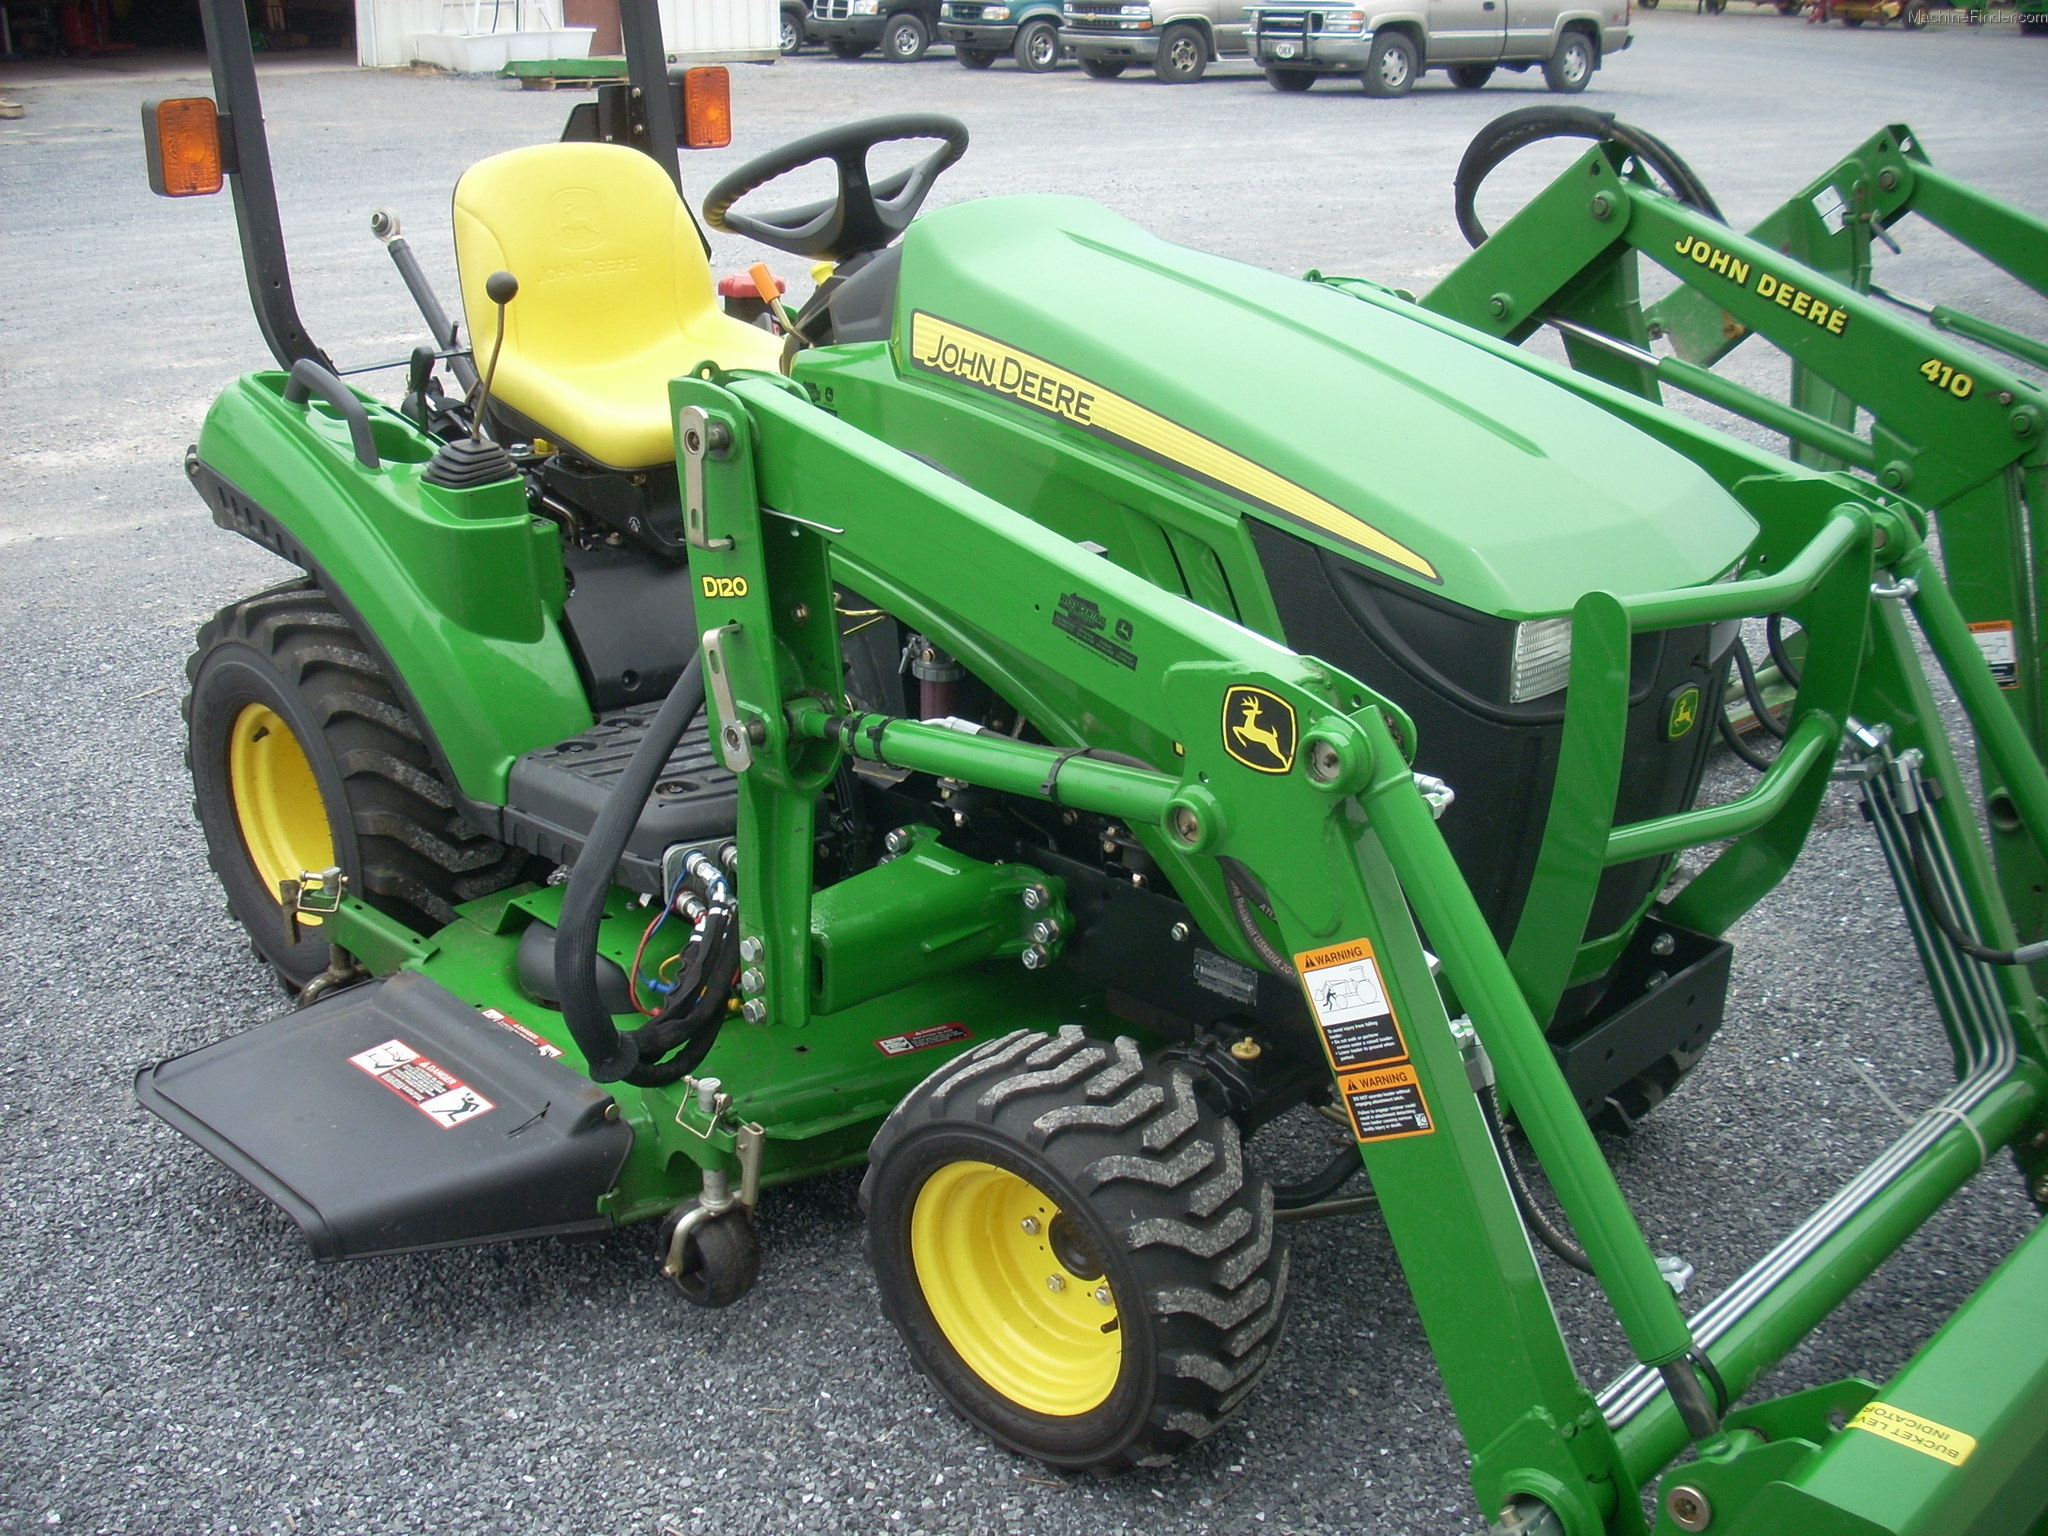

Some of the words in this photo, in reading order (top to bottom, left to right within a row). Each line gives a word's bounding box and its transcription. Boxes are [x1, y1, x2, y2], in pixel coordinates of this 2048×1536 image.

[582, 256, 639, 277] DEERE
[1674, 234, 1751, 285] JOHN
[1755, 272, 1849, 336] DEERE
[927, 335, 996, 383] JOHN
[999, 356, 1095, 422] DEERE
[1919, 357, 1974, 399] 410
[702, 576, 748, 598] D120
[1315, 946, 1364, 966] WARNING
[425, 1064, 457, 1085] DANGER
[1359, 1071, 1408, 1089] WARNING
[1489, 1084, 1503, 1128] TLAFLEX
[1507, 1148, 1518, 1172] INCH
[1515, 1172, 1529, 1193] 3000
[1526, 1193, 1537, 1209] PSI
[1535, 1208, 1551, 1227] MAX
[1855, 1416, 1889, 1431] LEV
[1863, 1406, 1951, 1441] INDICATOR
[1890, 1427, 1960, 1459] BUCKET
